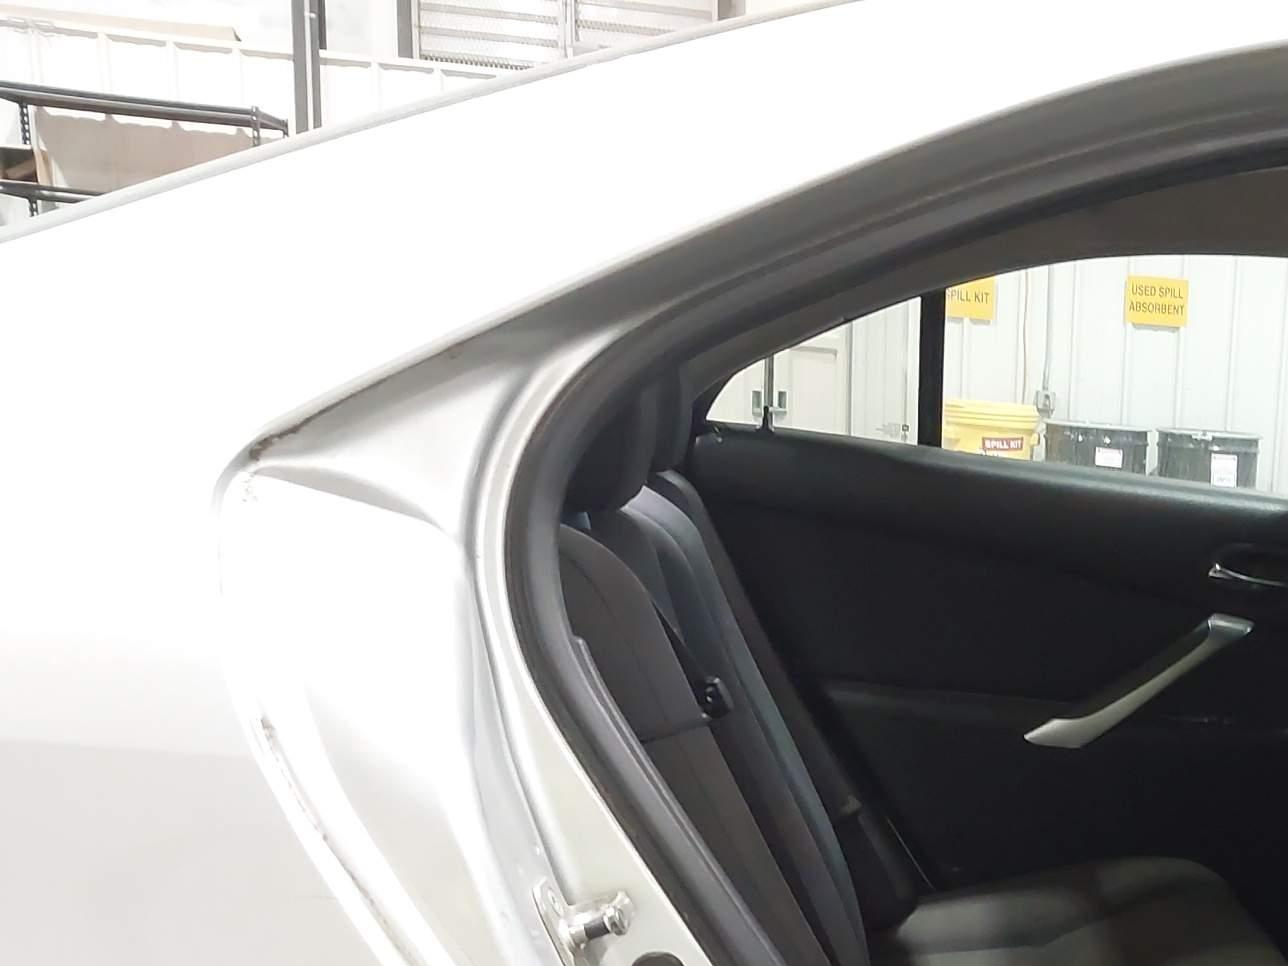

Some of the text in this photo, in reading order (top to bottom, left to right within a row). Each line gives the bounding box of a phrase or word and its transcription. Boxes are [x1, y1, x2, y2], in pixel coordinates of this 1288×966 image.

[974, 290, 990, 304] KIT
[1131, 282, 1184, 299] USED SPILL
[1129, 300, 1184, 316] ABSORBENT
[984, 439, 1022, 449] SPILL KIT
